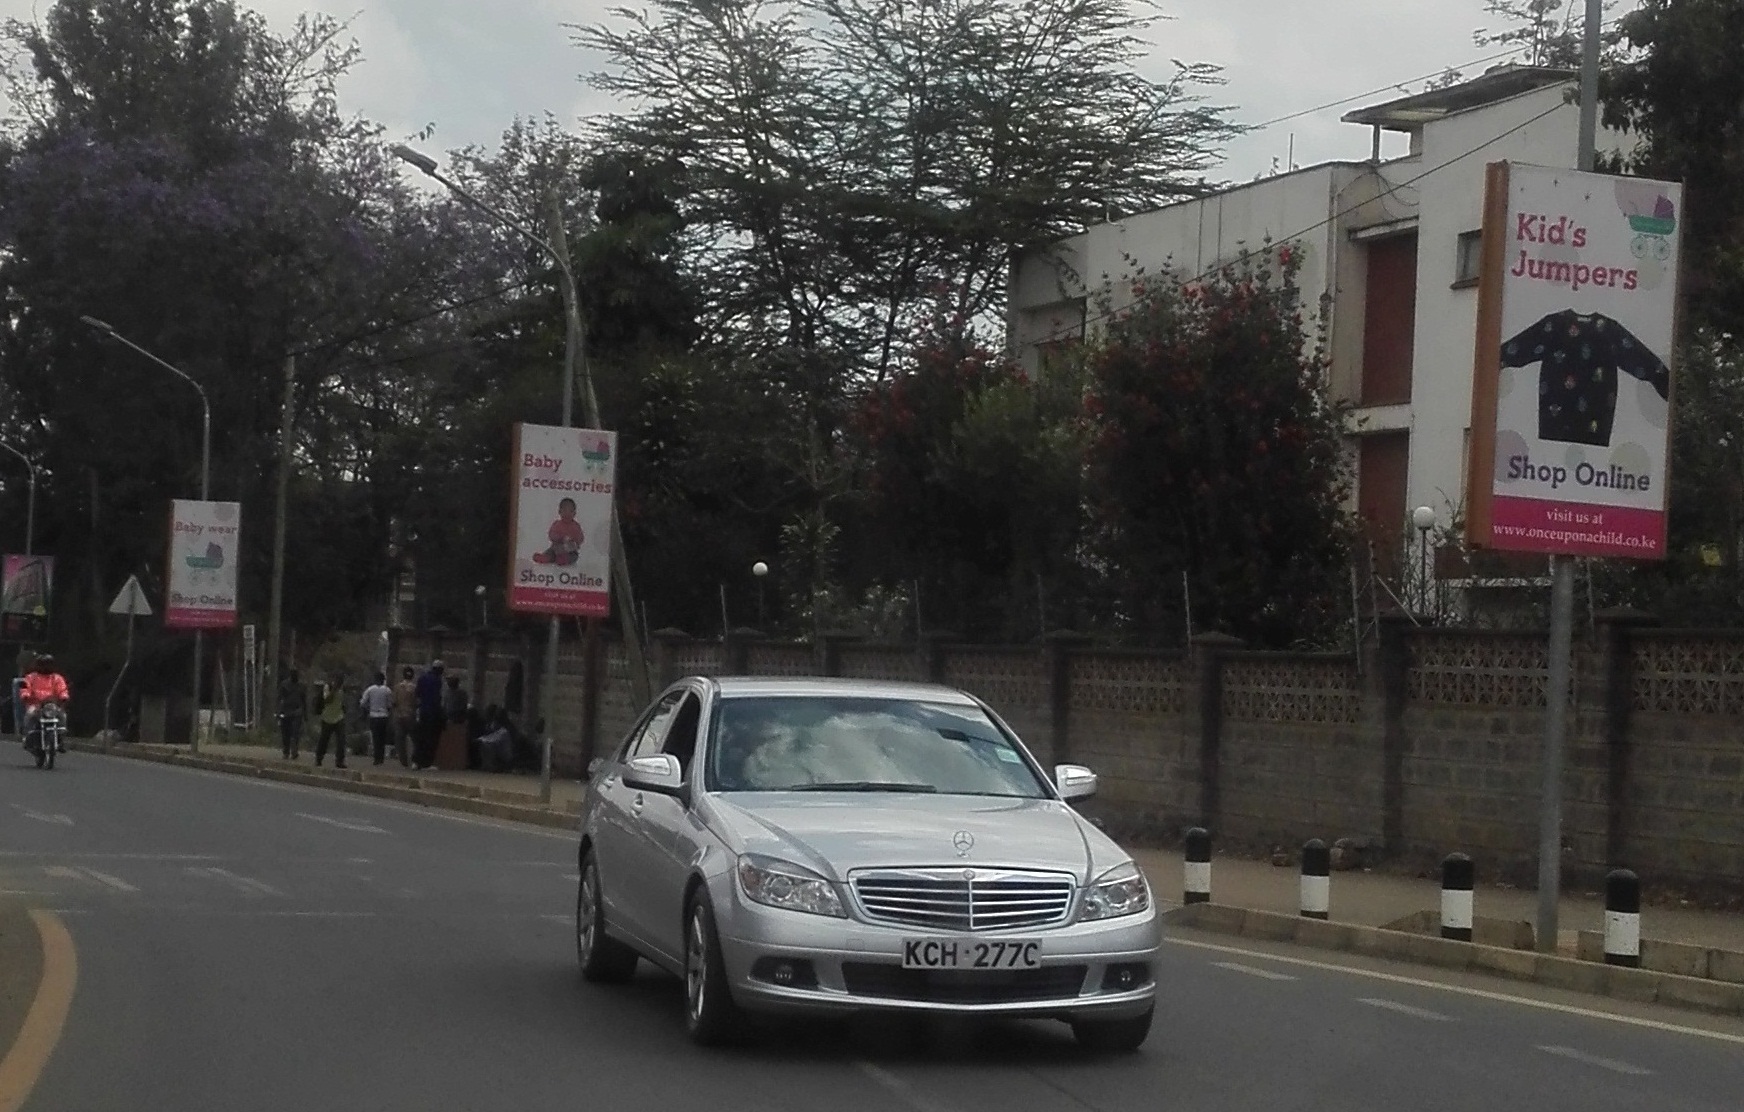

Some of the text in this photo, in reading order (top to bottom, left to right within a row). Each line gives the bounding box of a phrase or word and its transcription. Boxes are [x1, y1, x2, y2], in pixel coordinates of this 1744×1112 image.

[1516, 211, 1586, 248] Kid's
[1511, 250, 1638, 291] Jumpers
[523, 453, 562, 473] Baby
[1507, 454, 1650, 491] Shop Online
[522, 476, 612, 494] accessories
[175, 521, 205, 535] Baby
[1546, 508, 1603, 525] visit us at
[1493, 523, 1657, 549] www.onceuponachild.co.ke
[520, 569, 603, 587] Shop Online
[905, 941, 1038, 967] KCH 277C
